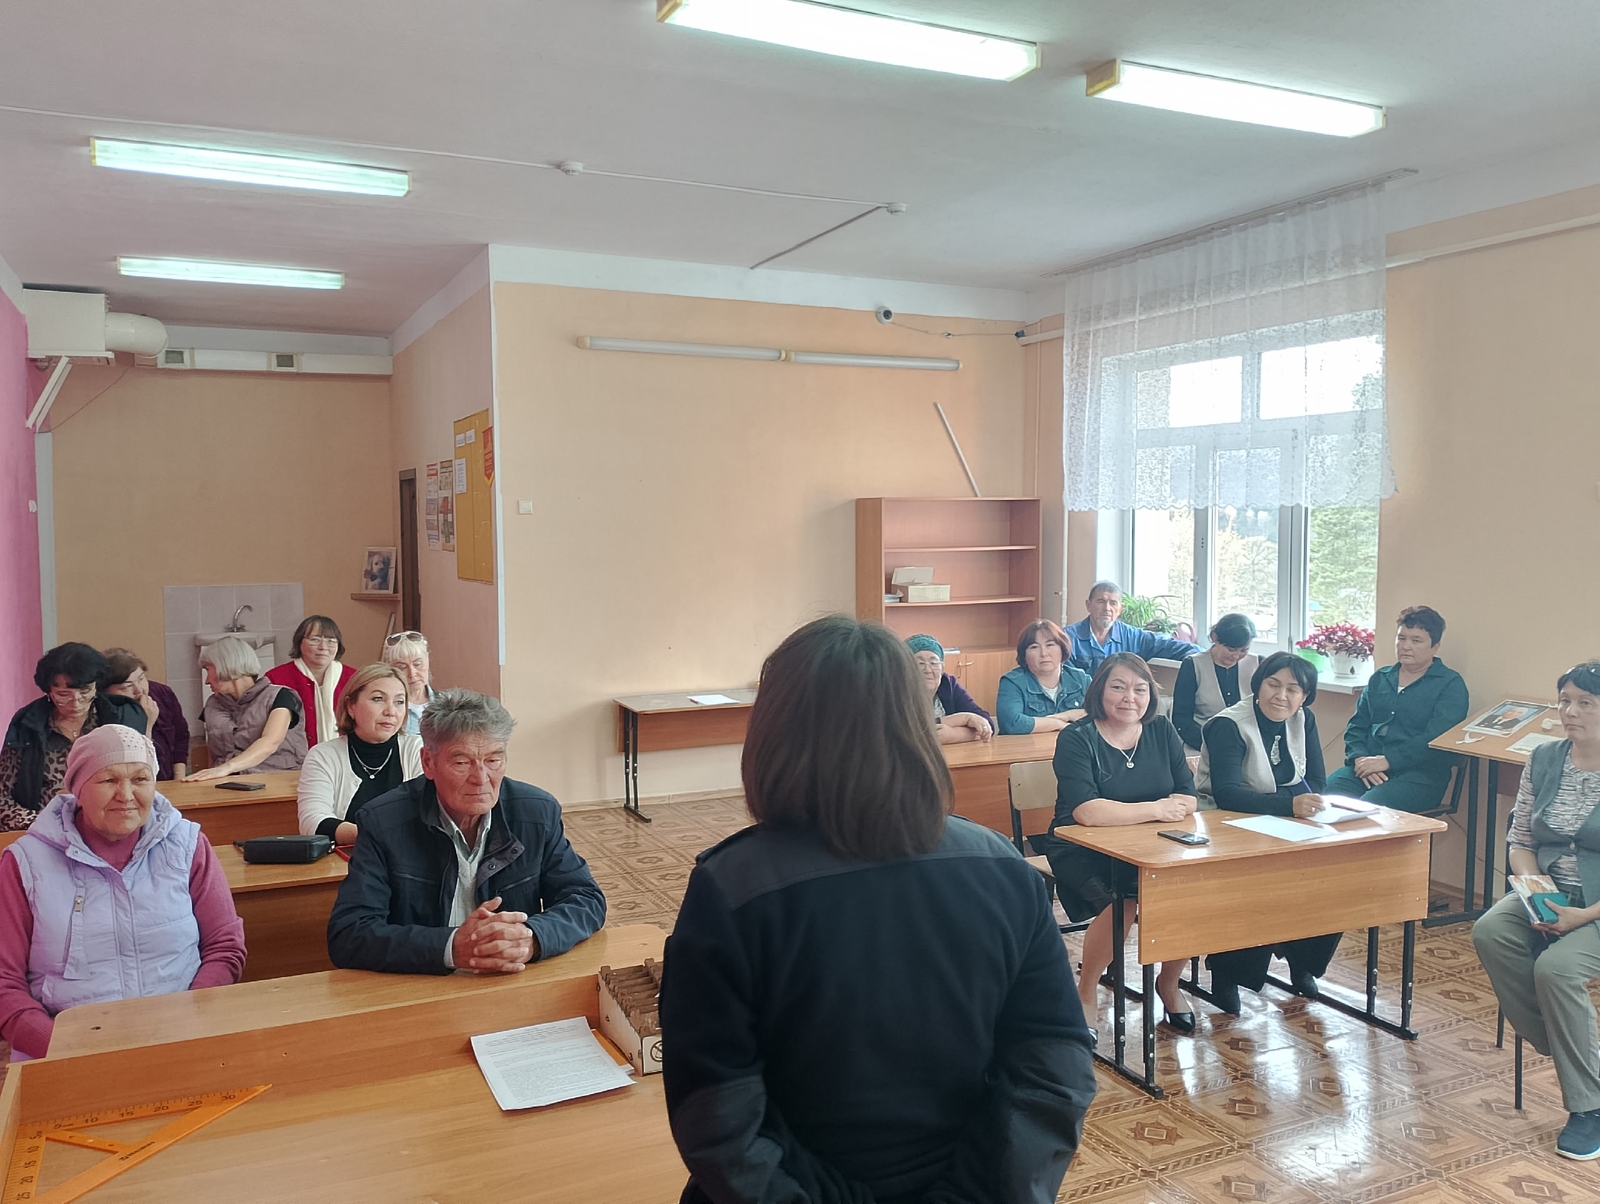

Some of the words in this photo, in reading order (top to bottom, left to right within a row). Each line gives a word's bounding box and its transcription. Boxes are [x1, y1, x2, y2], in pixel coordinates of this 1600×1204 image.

[153, 1105, 169, 1113] 20
[27, 1145, 39, 1153] 10
[24, 1160, 36, 1168] 15
[20, 1175, 34, 1184] 20
[16, 1192, 30, 1200] 25
